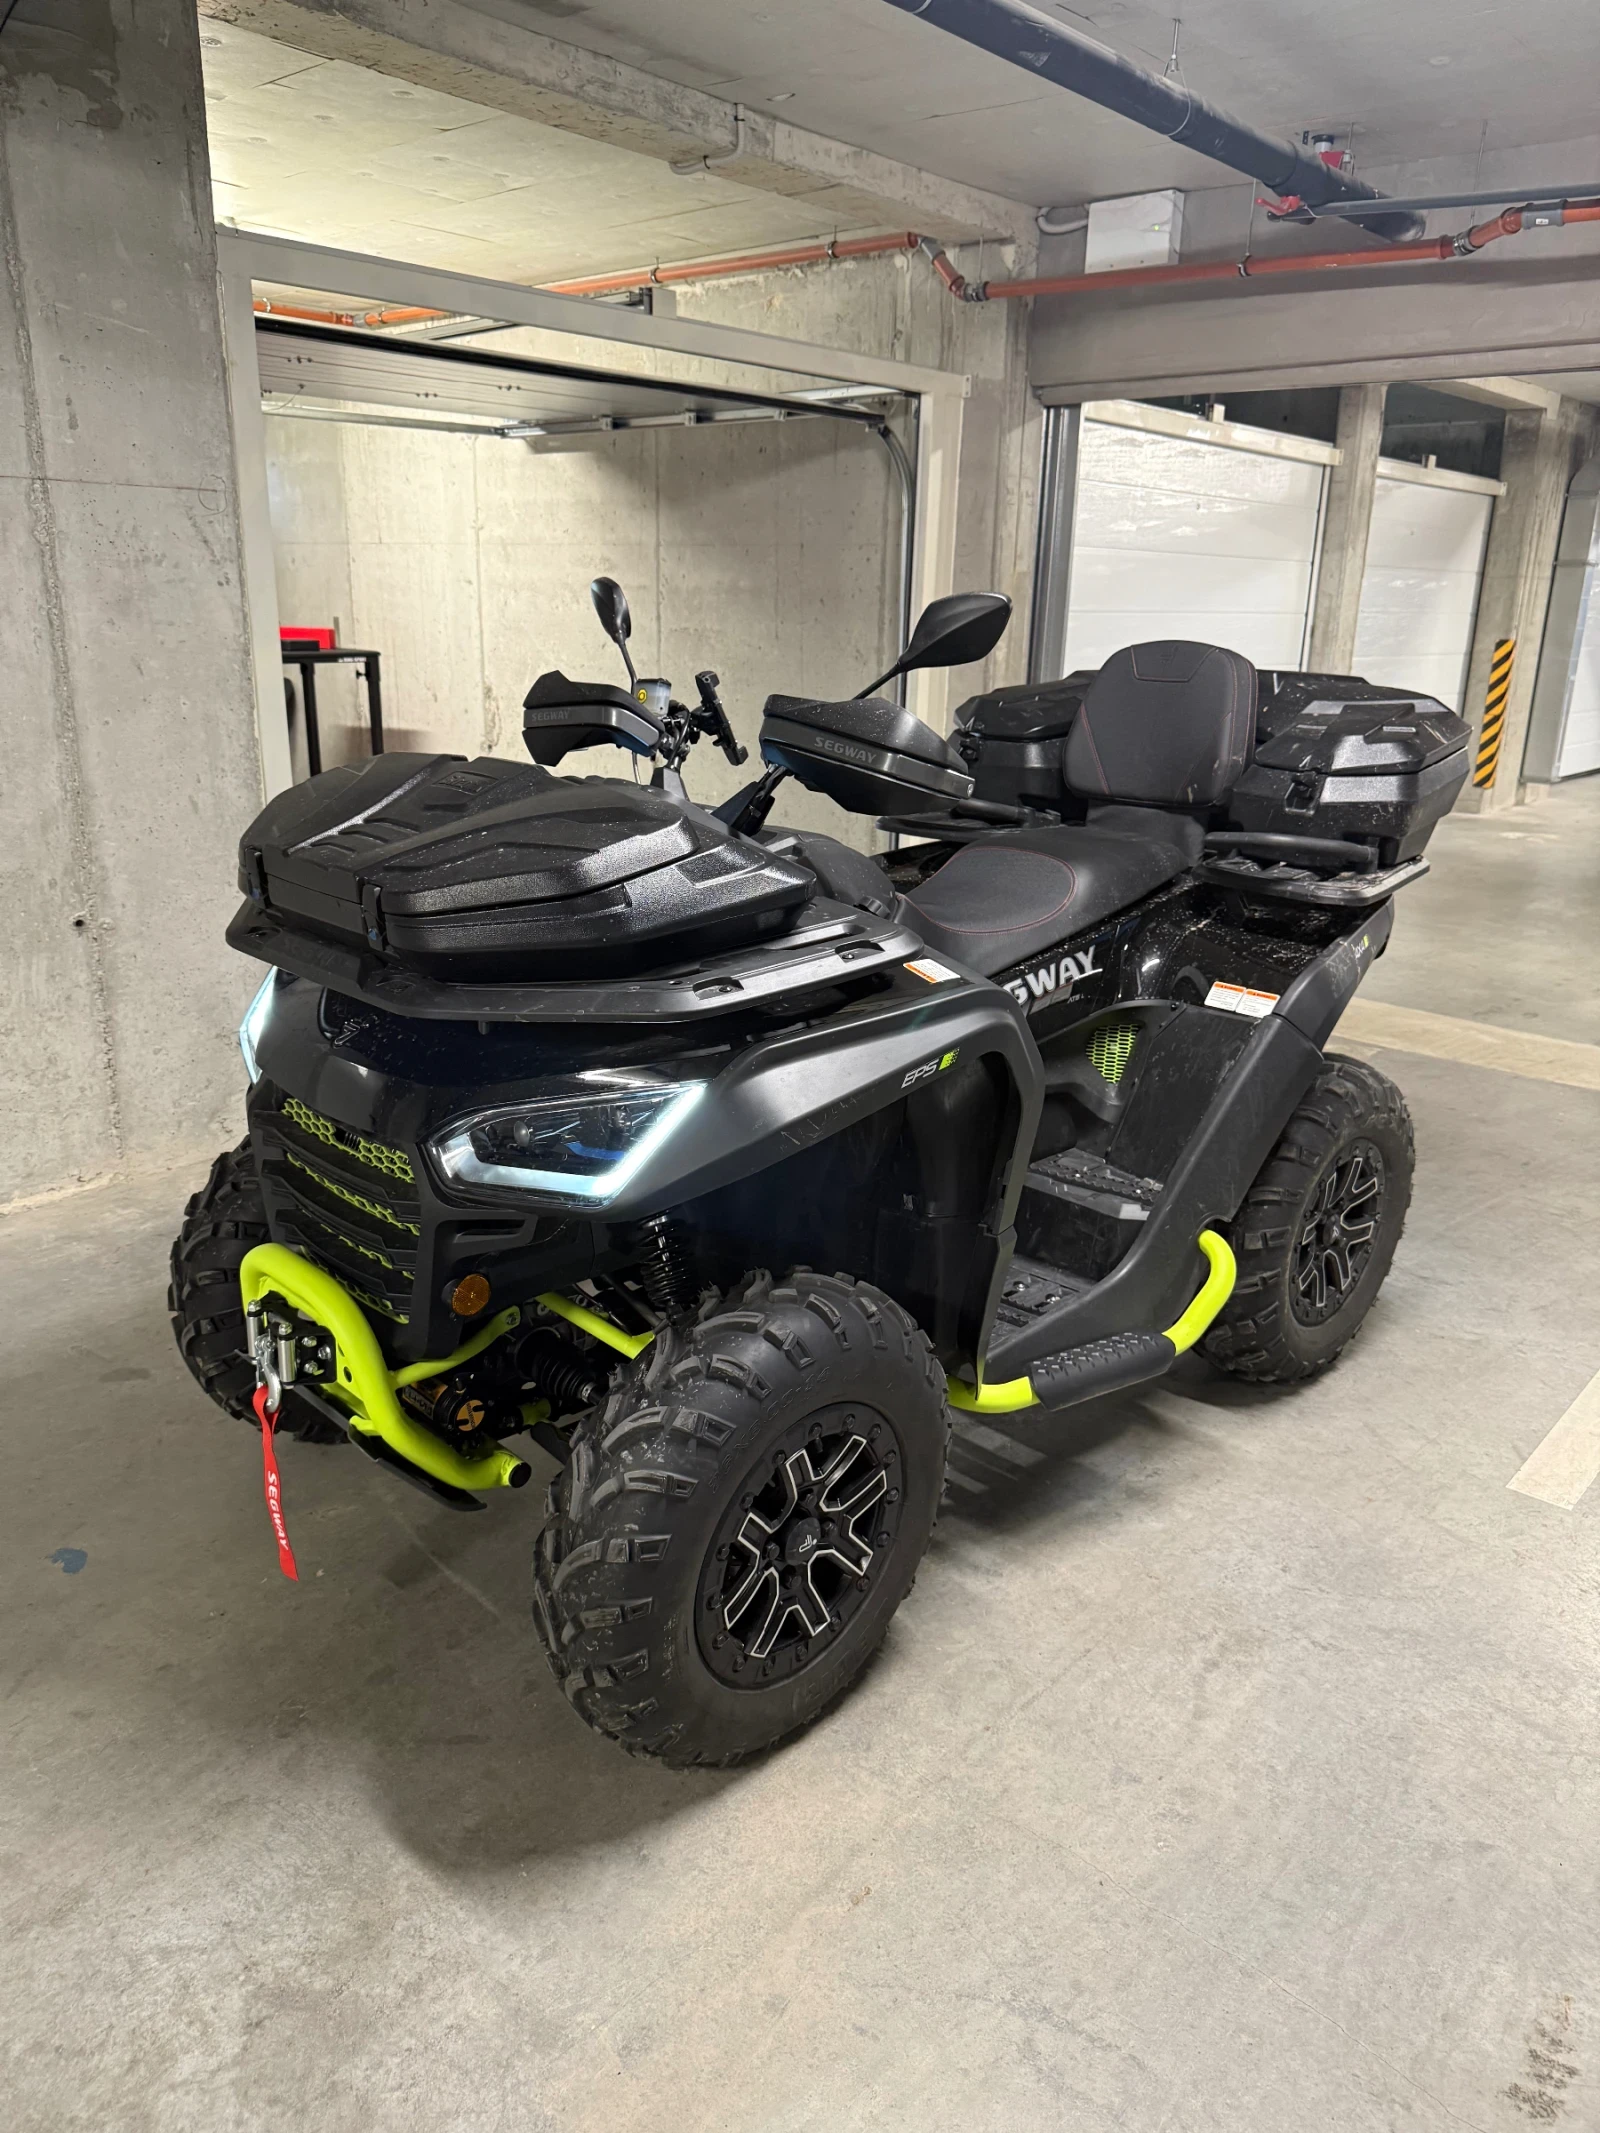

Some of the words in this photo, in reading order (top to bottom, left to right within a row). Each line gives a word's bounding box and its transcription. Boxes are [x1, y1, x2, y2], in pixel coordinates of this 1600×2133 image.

[531, 710, 570, 721] SEGWAY
[814, 736, 876, 764] SEGWAY
[1002, 944, 1096, 1006] GWAY
[901, 1058, 939, 1089] EPS
[267, 1470, 289, 1551] SEGWAY
